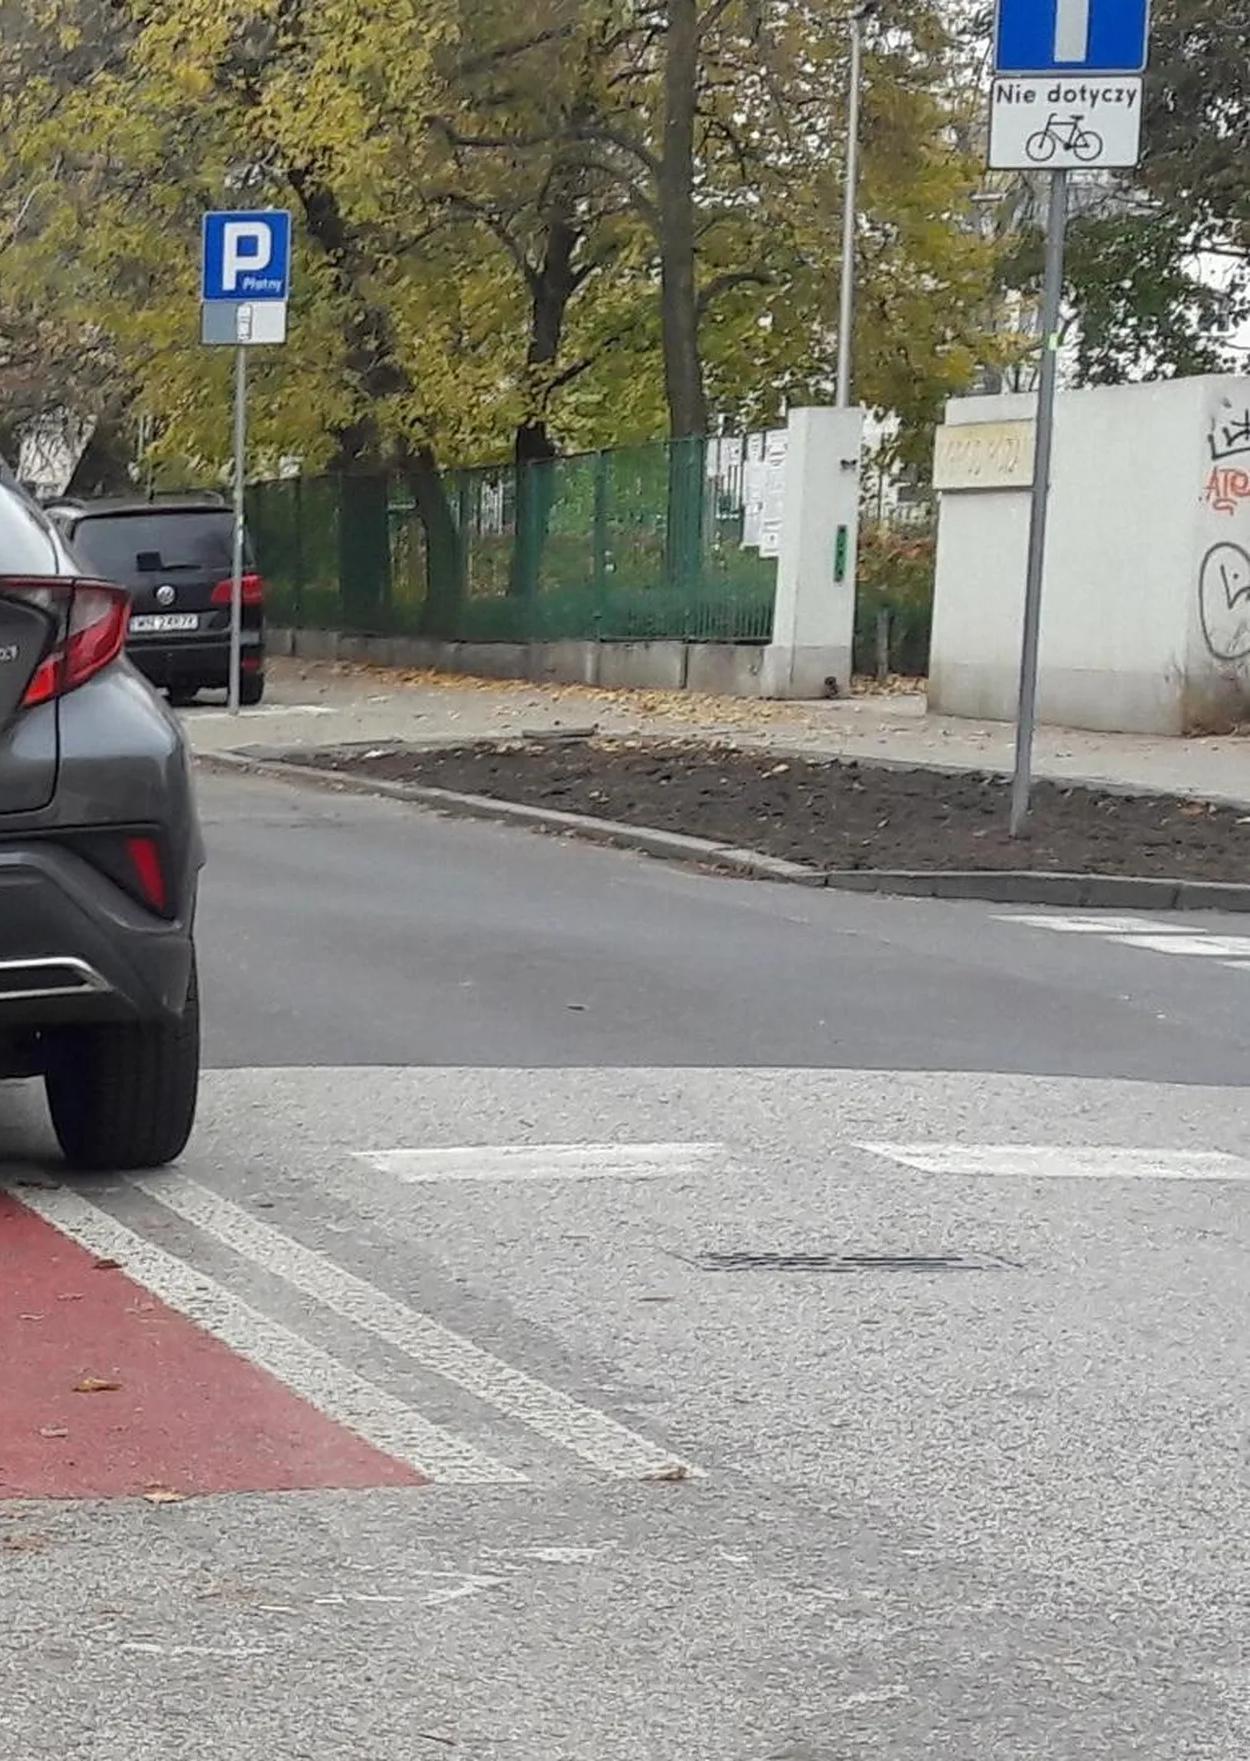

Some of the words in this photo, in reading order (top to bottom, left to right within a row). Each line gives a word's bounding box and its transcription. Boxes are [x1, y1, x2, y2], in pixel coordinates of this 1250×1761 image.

[997, 84, 1036, 104] Nie
[1047, 83, 1137, 108] dotyczy
[222, 221, 271, 290] P
